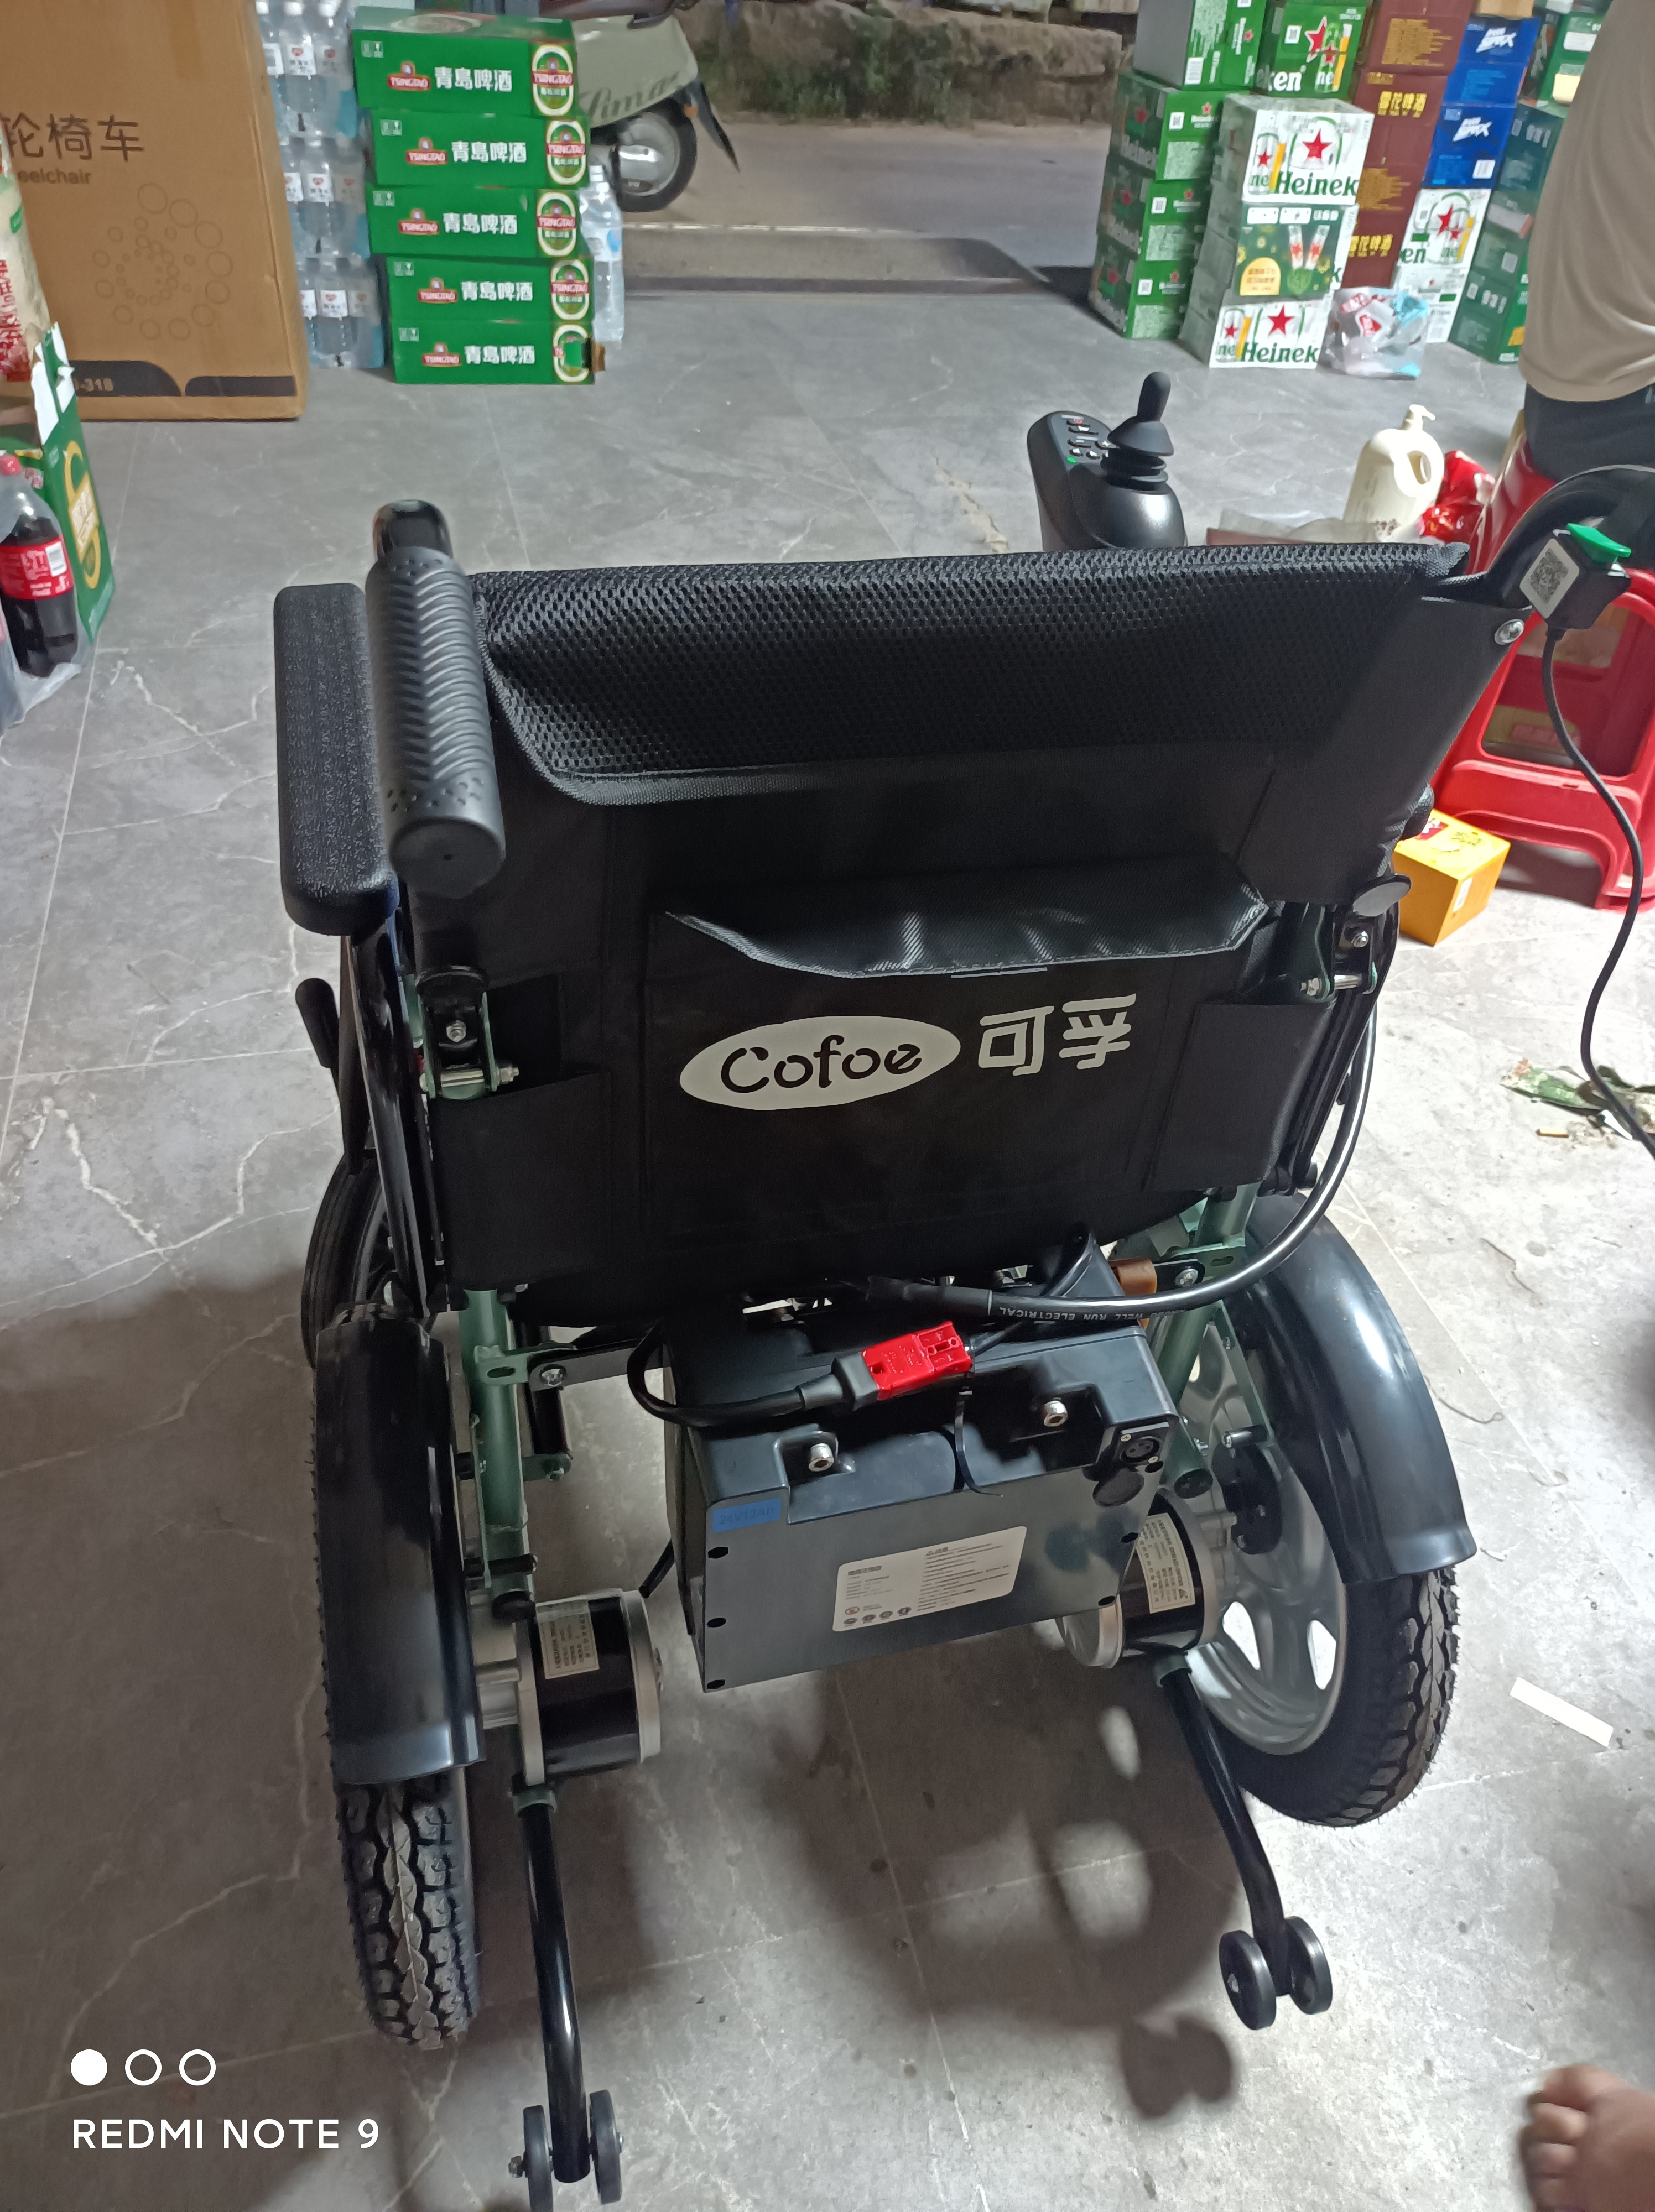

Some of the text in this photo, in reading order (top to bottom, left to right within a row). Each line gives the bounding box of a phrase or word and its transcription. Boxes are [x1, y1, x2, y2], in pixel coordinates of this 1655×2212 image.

[1, 112, 145, 162] 轮椅车
[1274, 170, 1360, 196] Heinek
[1241, 341, 1319, 363] Heinek
[978, 993, 1137, 1076] 可孚
[720, 1034, 922, 1094] Cofoe
[999, 1307, 1076, 1321] ELECTRICAL
[1084, 1313, 1107, 1321] RUN
